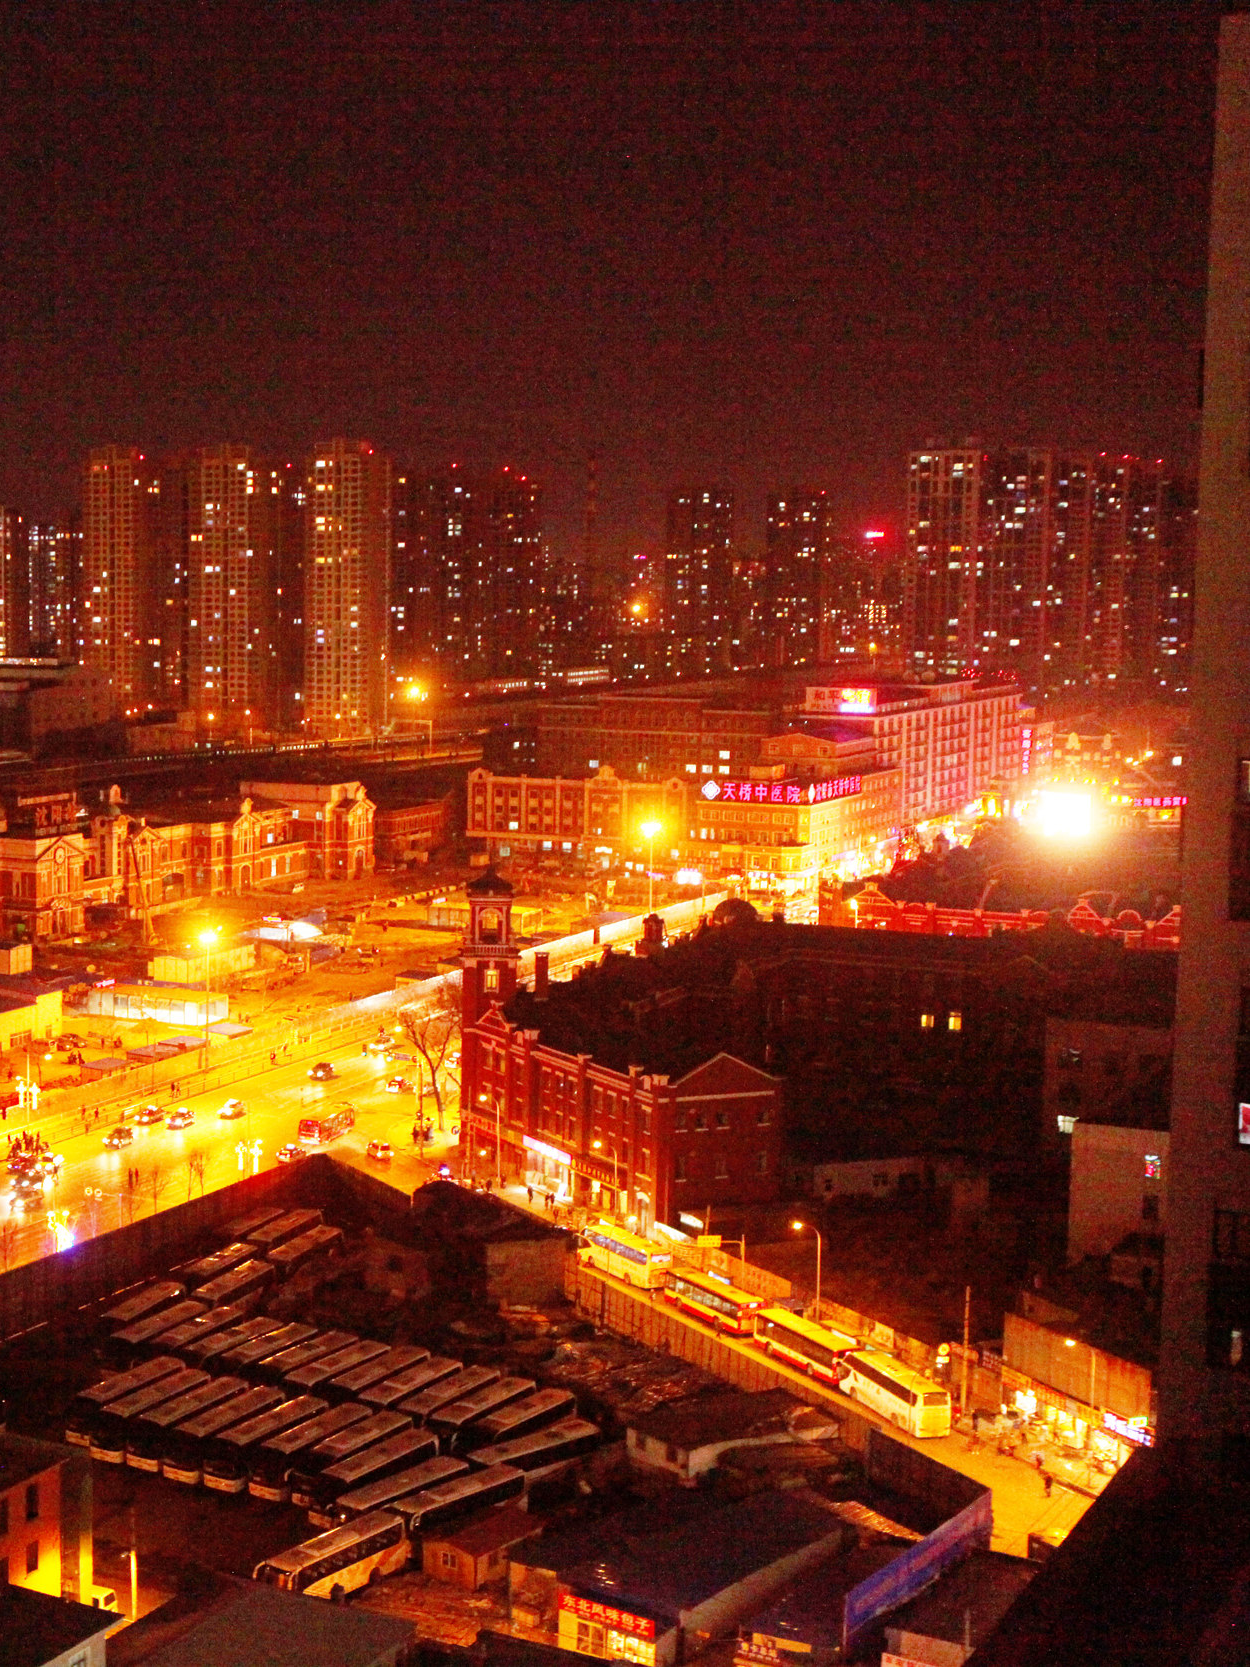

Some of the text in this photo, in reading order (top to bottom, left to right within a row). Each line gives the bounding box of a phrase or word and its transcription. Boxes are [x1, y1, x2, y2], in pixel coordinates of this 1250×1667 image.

[722, 782, 801, 803] 天桥中医院
[562, 1595, 651, 1630] 东北风味包子
